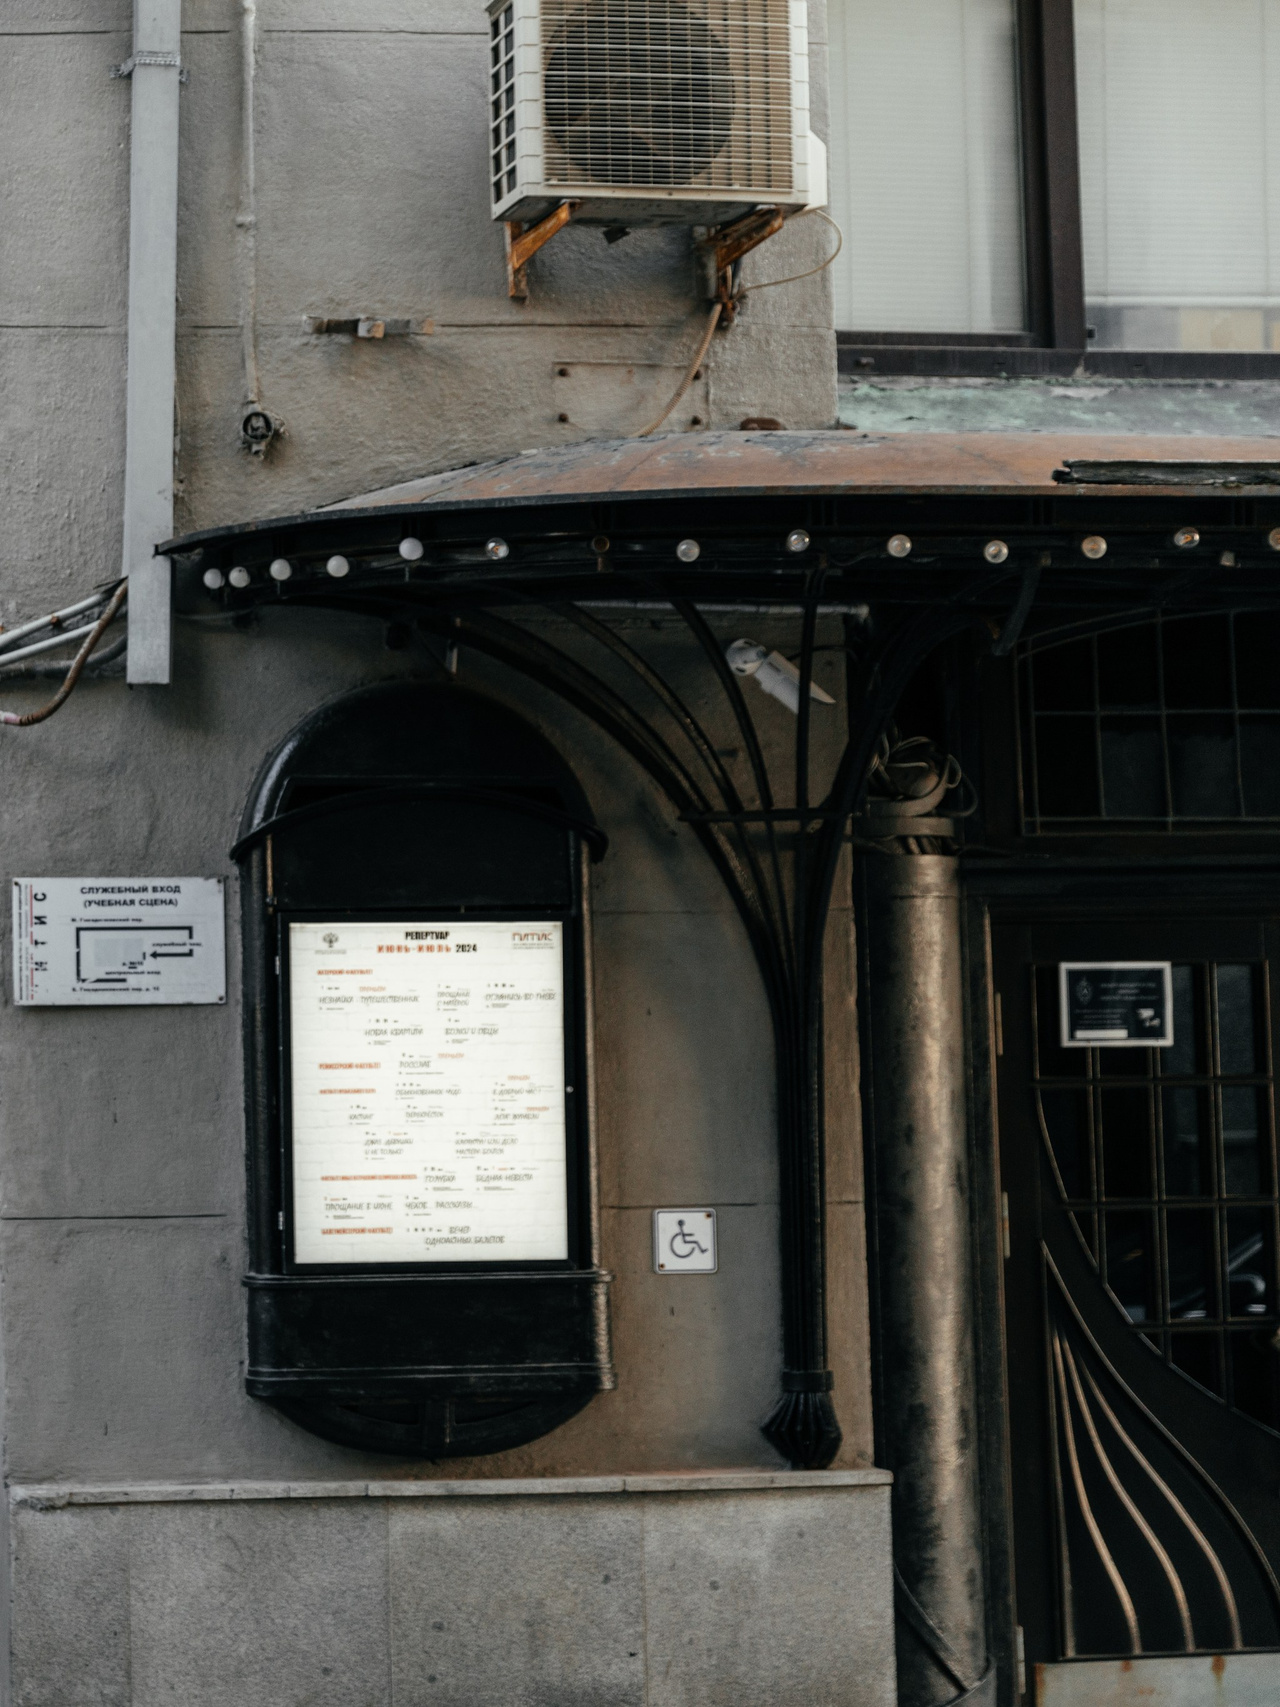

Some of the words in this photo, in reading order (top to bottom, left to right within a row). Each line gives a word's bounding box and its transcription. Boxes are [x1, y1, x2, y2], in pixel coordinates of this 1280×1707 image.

[80, 885, 149, 894] СЛУЖЕБНЫЙ
[152, 885, 181, 894] ВХОД
[84, 898, 136, 908] (УЧЕБНАЯ
[139, 898, 178, 908] СЦЕНА)
[405, 931, 450, 940] РЕПЕРТУАР
[512, 932, 554, 941] ГИТИС
[456, 944, 477, 953] 2024
[325, 1203, 363, 1211] ПРОЩАНИЕ
